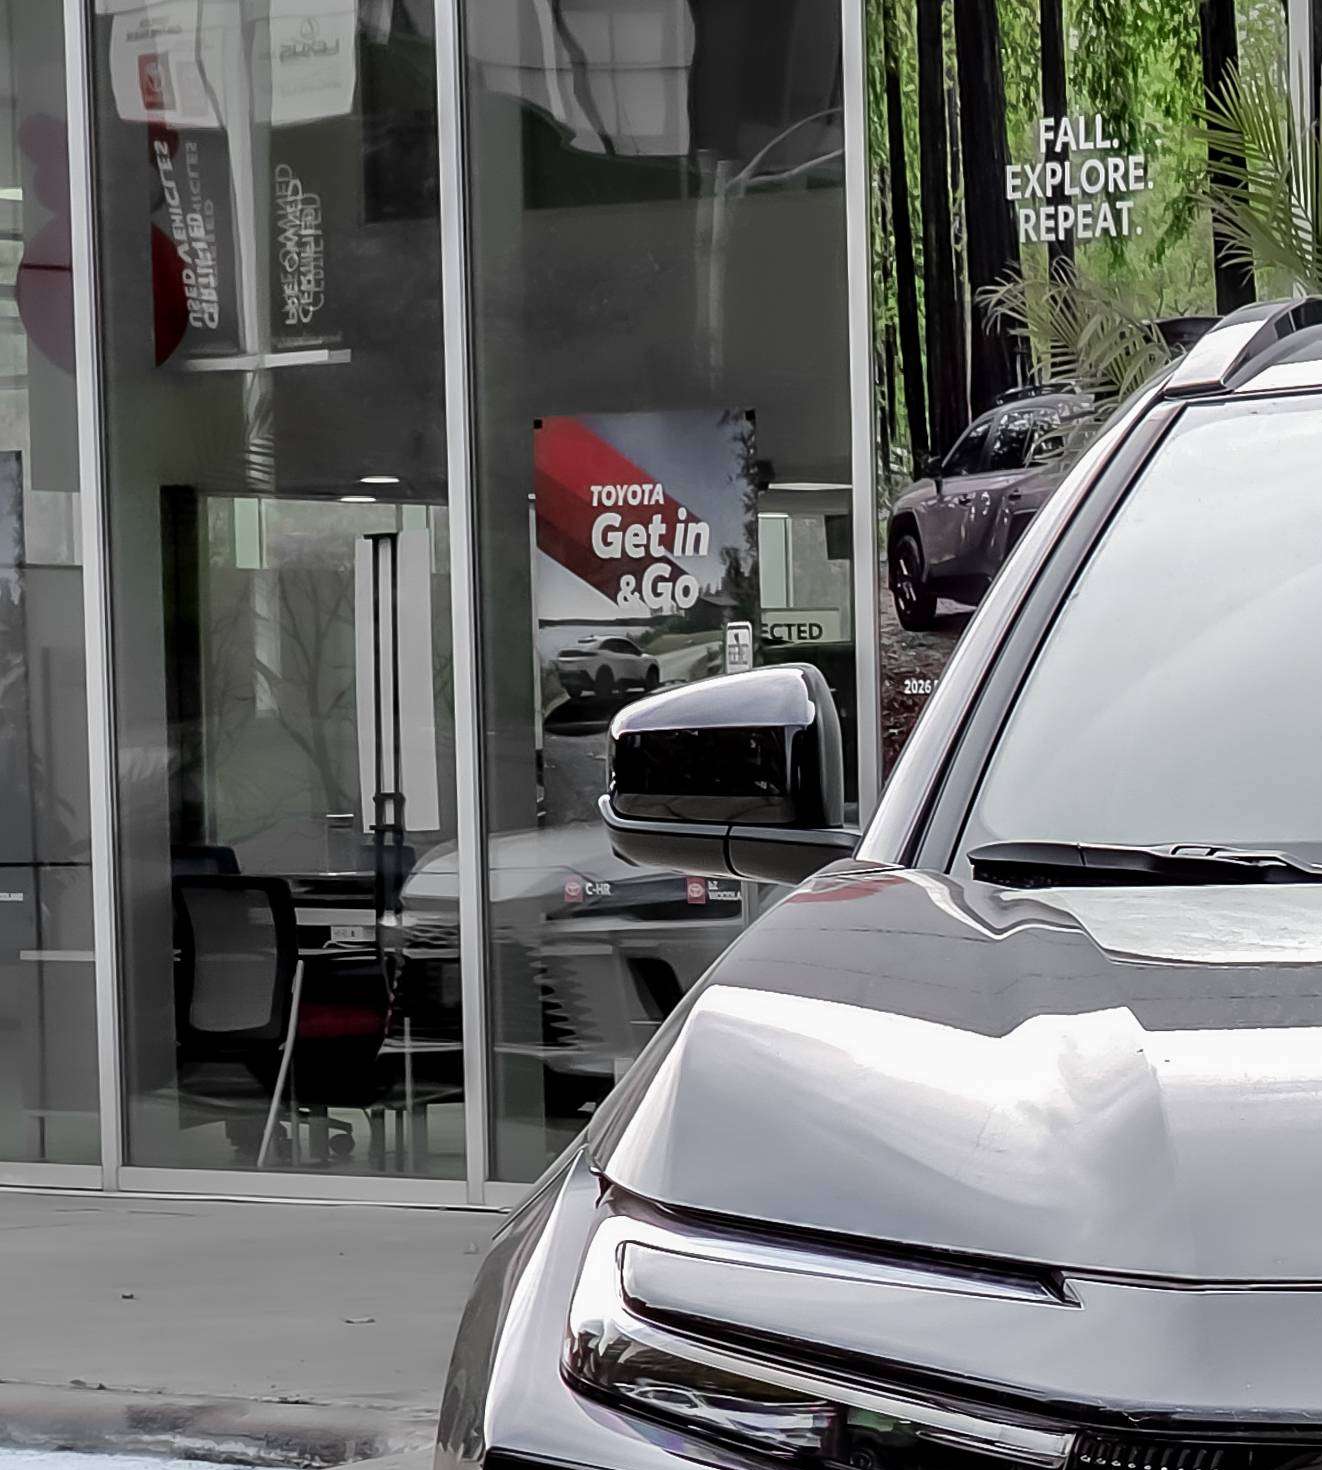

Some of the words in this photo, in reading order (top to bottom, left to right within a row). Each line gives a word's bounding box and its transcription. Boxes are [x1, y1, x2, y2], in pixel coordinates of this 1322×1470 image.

[1039, 113, 1120, 153] FALL.
[1005, 155, 1154, 201] EXPLORE.
[1018, 201, 1143, 243] REPEAT.
[590, 483, 665, 507] TOYOTA
[591, 512, 667, 559] Get
[673, 507, 710, 557] in
[616, 562, 700, 610] &Go
[904, 679, 932, 694] 2026
[585, 882, 612, 896] C-HR
